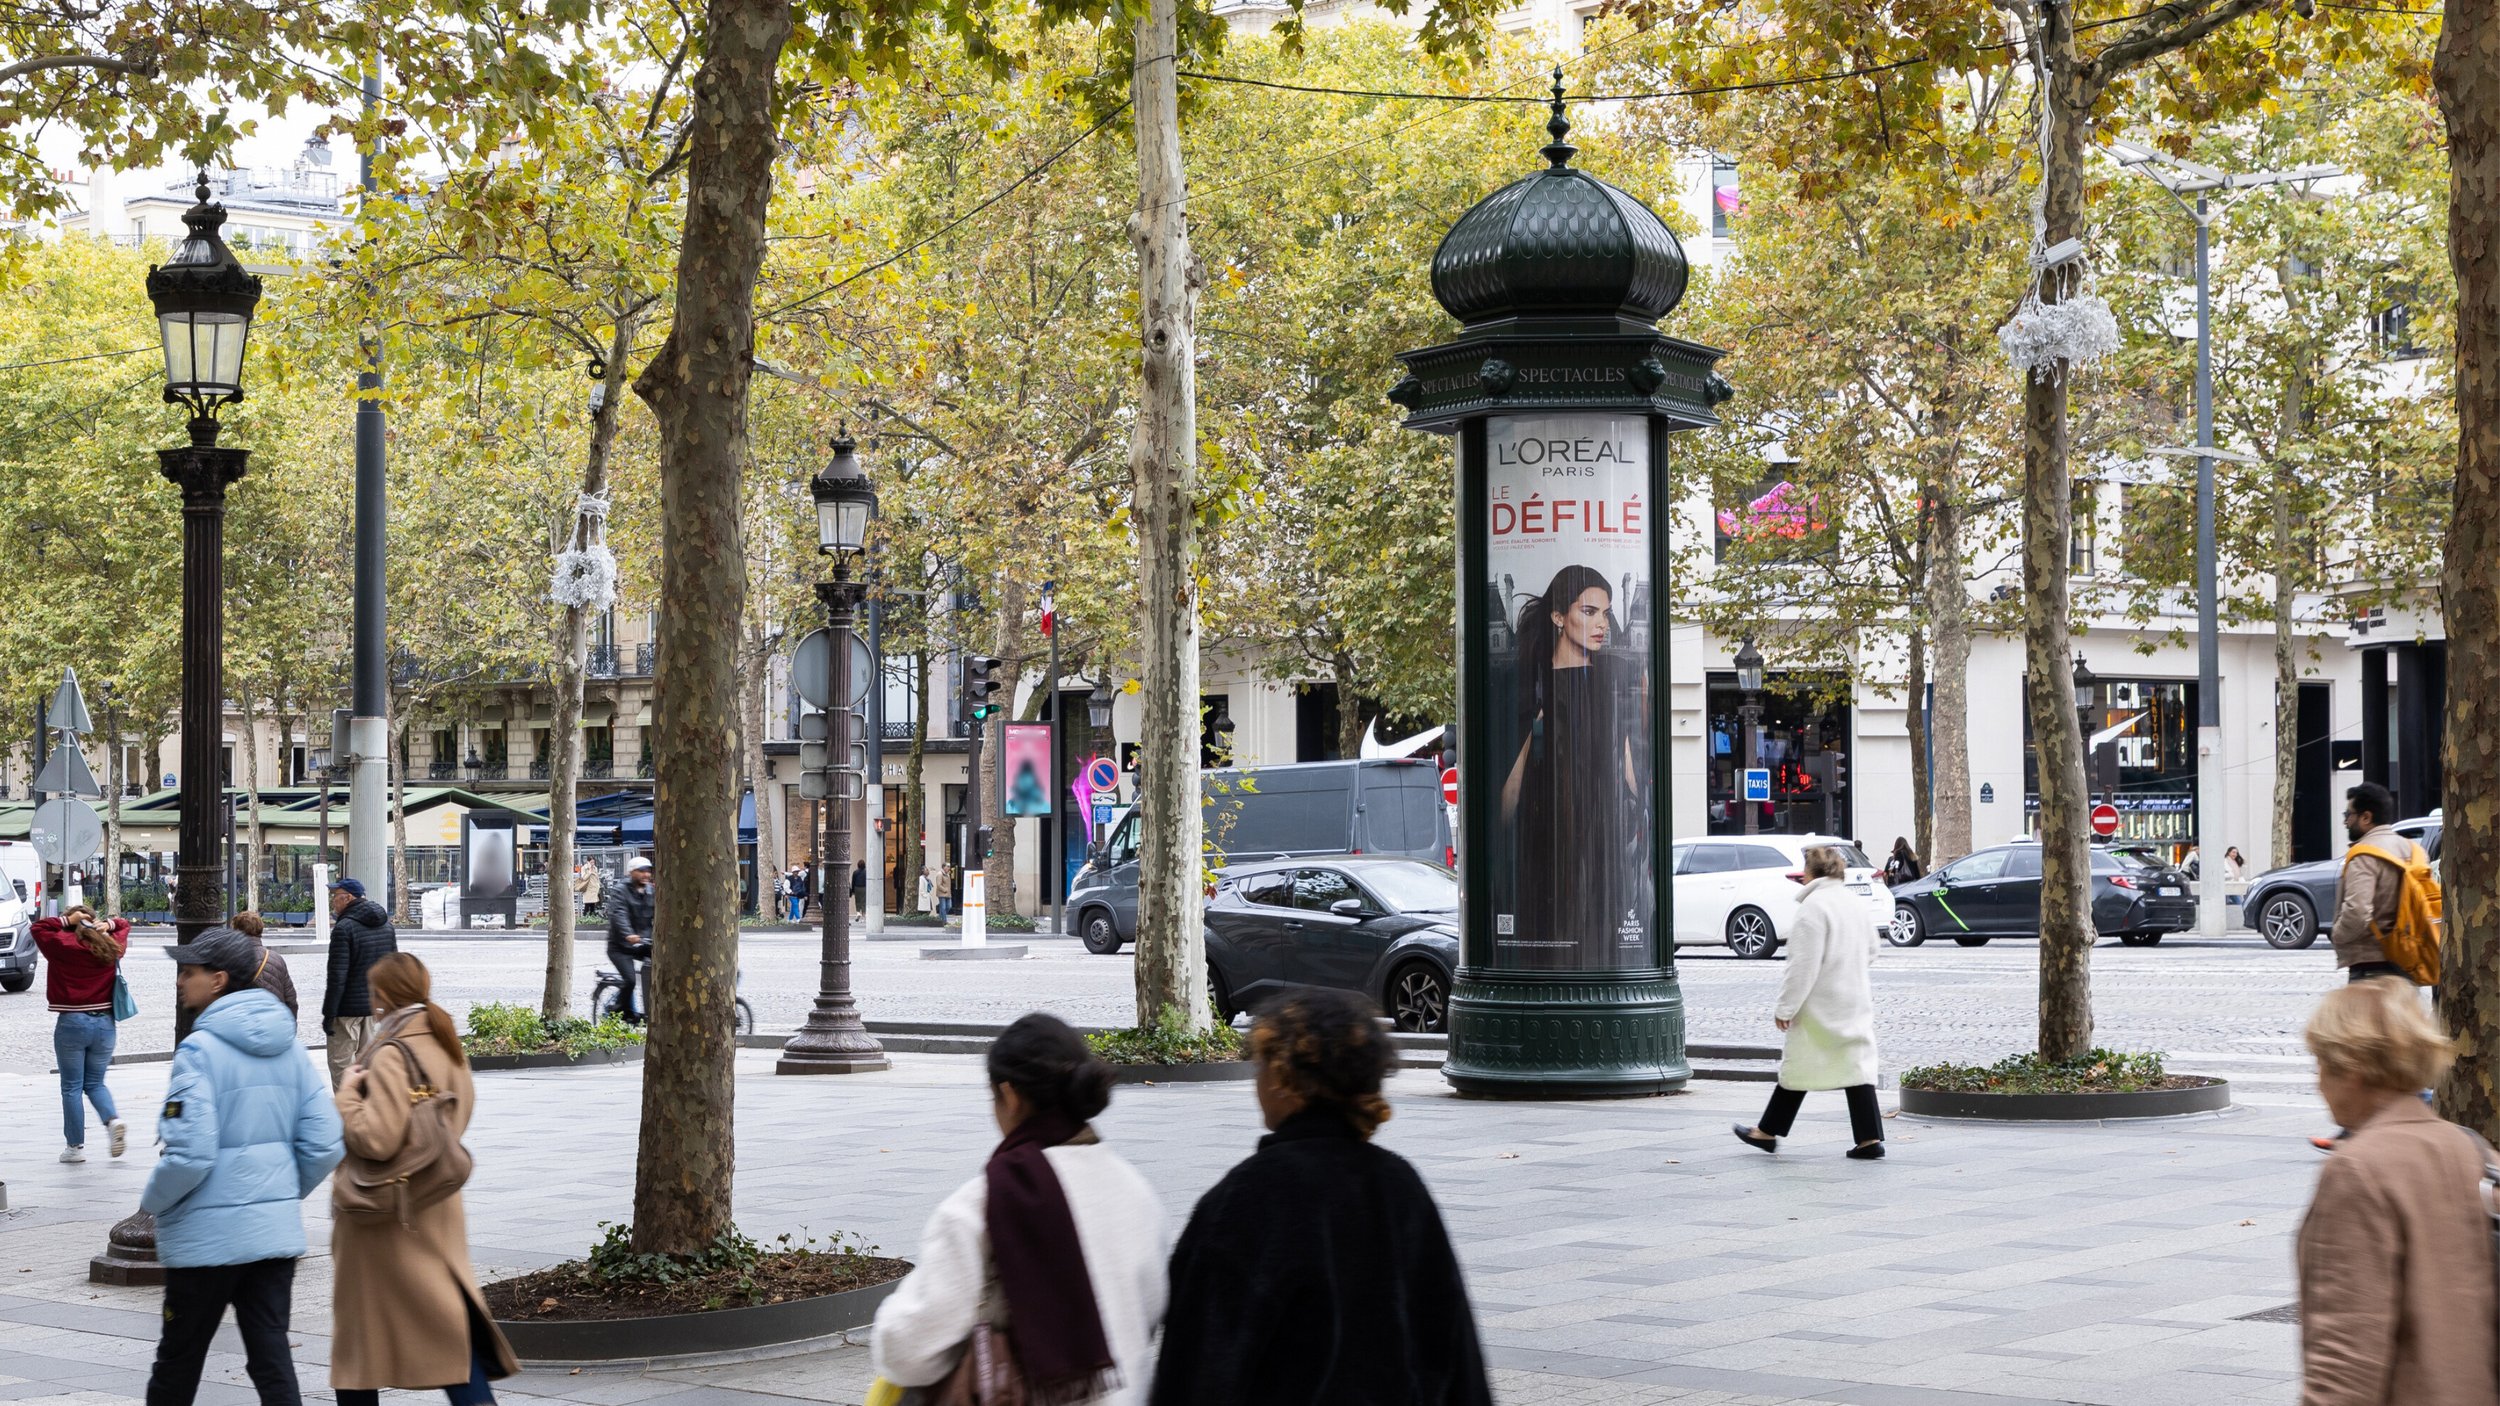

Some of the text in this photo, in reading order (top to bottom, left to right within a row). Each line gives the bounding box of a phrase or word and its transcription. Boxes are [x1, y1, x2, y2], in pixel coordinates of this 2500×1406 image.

[1421, 371, 1479, 395] SPECTACLES
[1519, 368, 1625, 382] SPECTACLES
[1663, 371, 1704, 392] PECTACLES
[1499, 437, 1635, 465] L'ORÉAL
[1492, 485, 1510, 500] LE
[1492, 492, 1642, 535] DÉFILÉ
[1748, 779, 1768, 789] TAXIS
